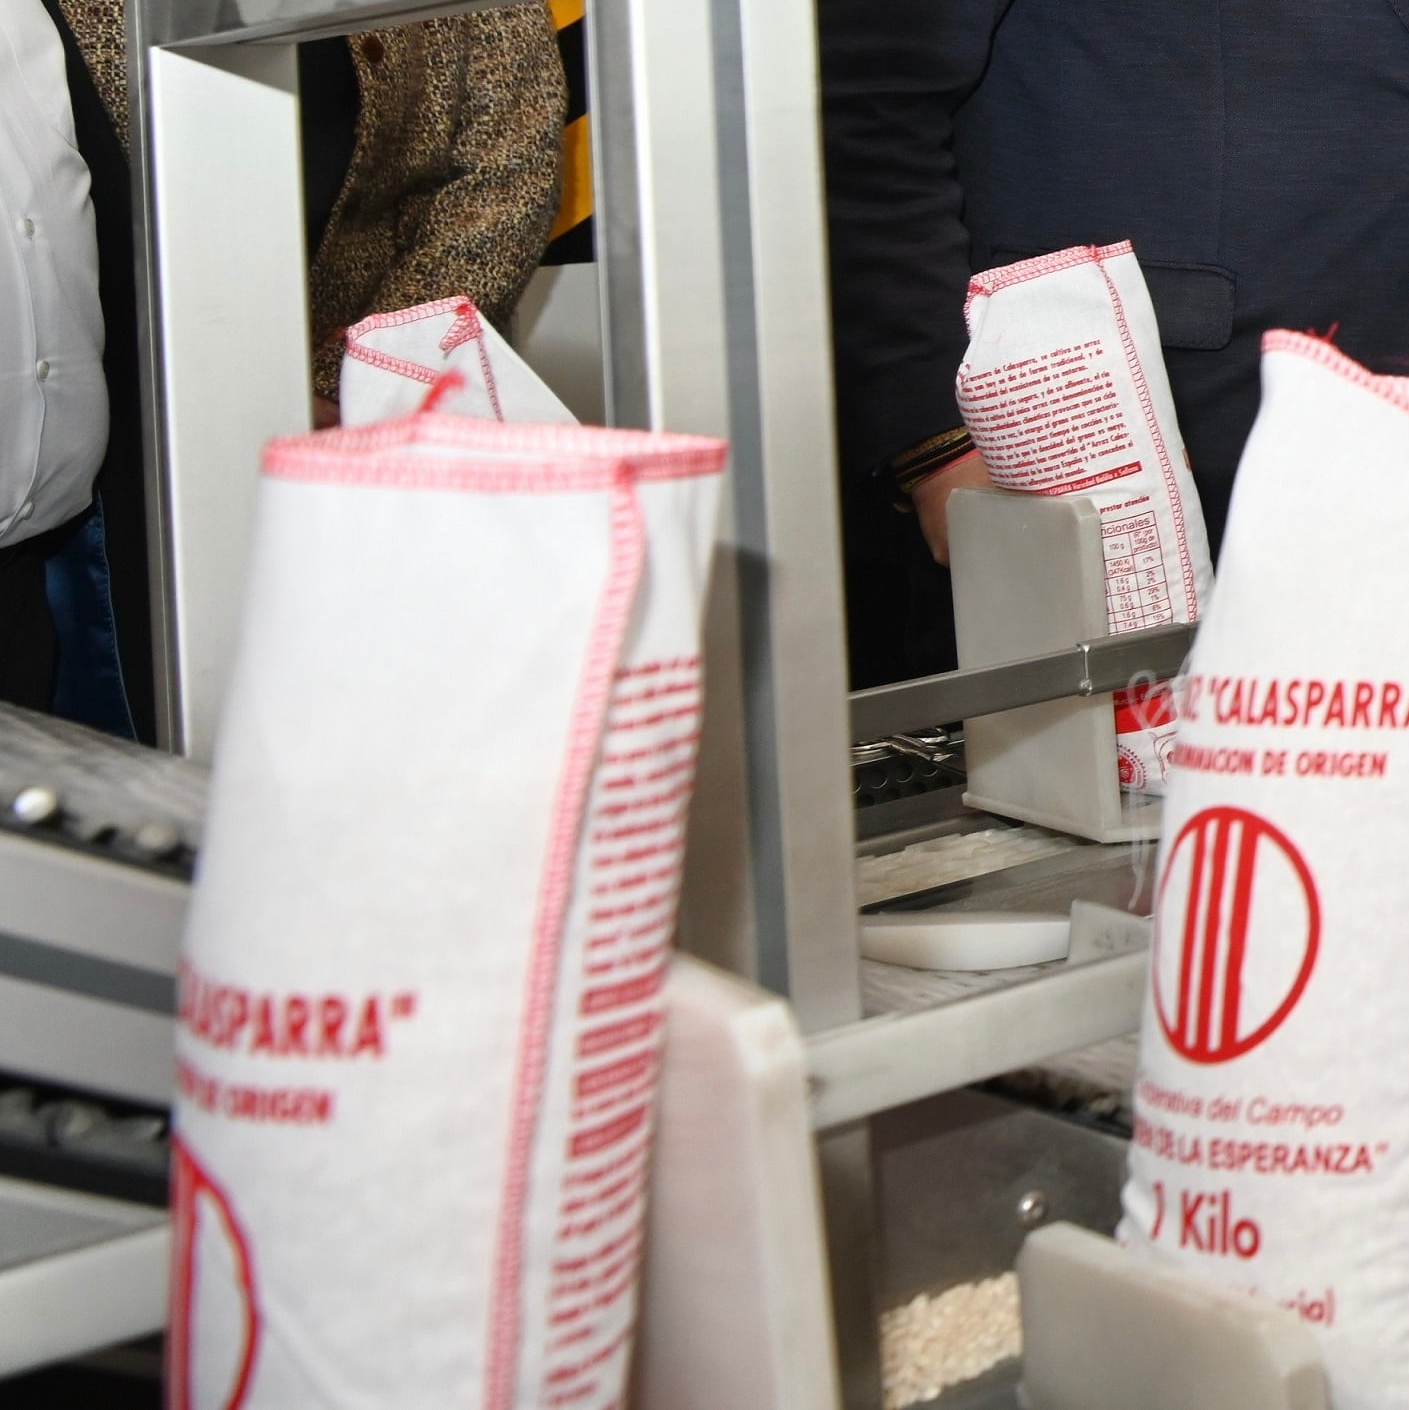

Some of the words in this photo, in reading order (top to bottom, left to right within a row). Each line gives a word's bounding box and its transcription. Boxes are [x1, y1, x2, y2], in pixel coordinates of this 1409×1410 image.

[1262, 751, 1287, 776] DE
[1296, 751, 1388, 778] ORIGEN
[1246, 1096, 1344, 1131] Campo
[1180, 1188, 1261, 1260] Kilo
